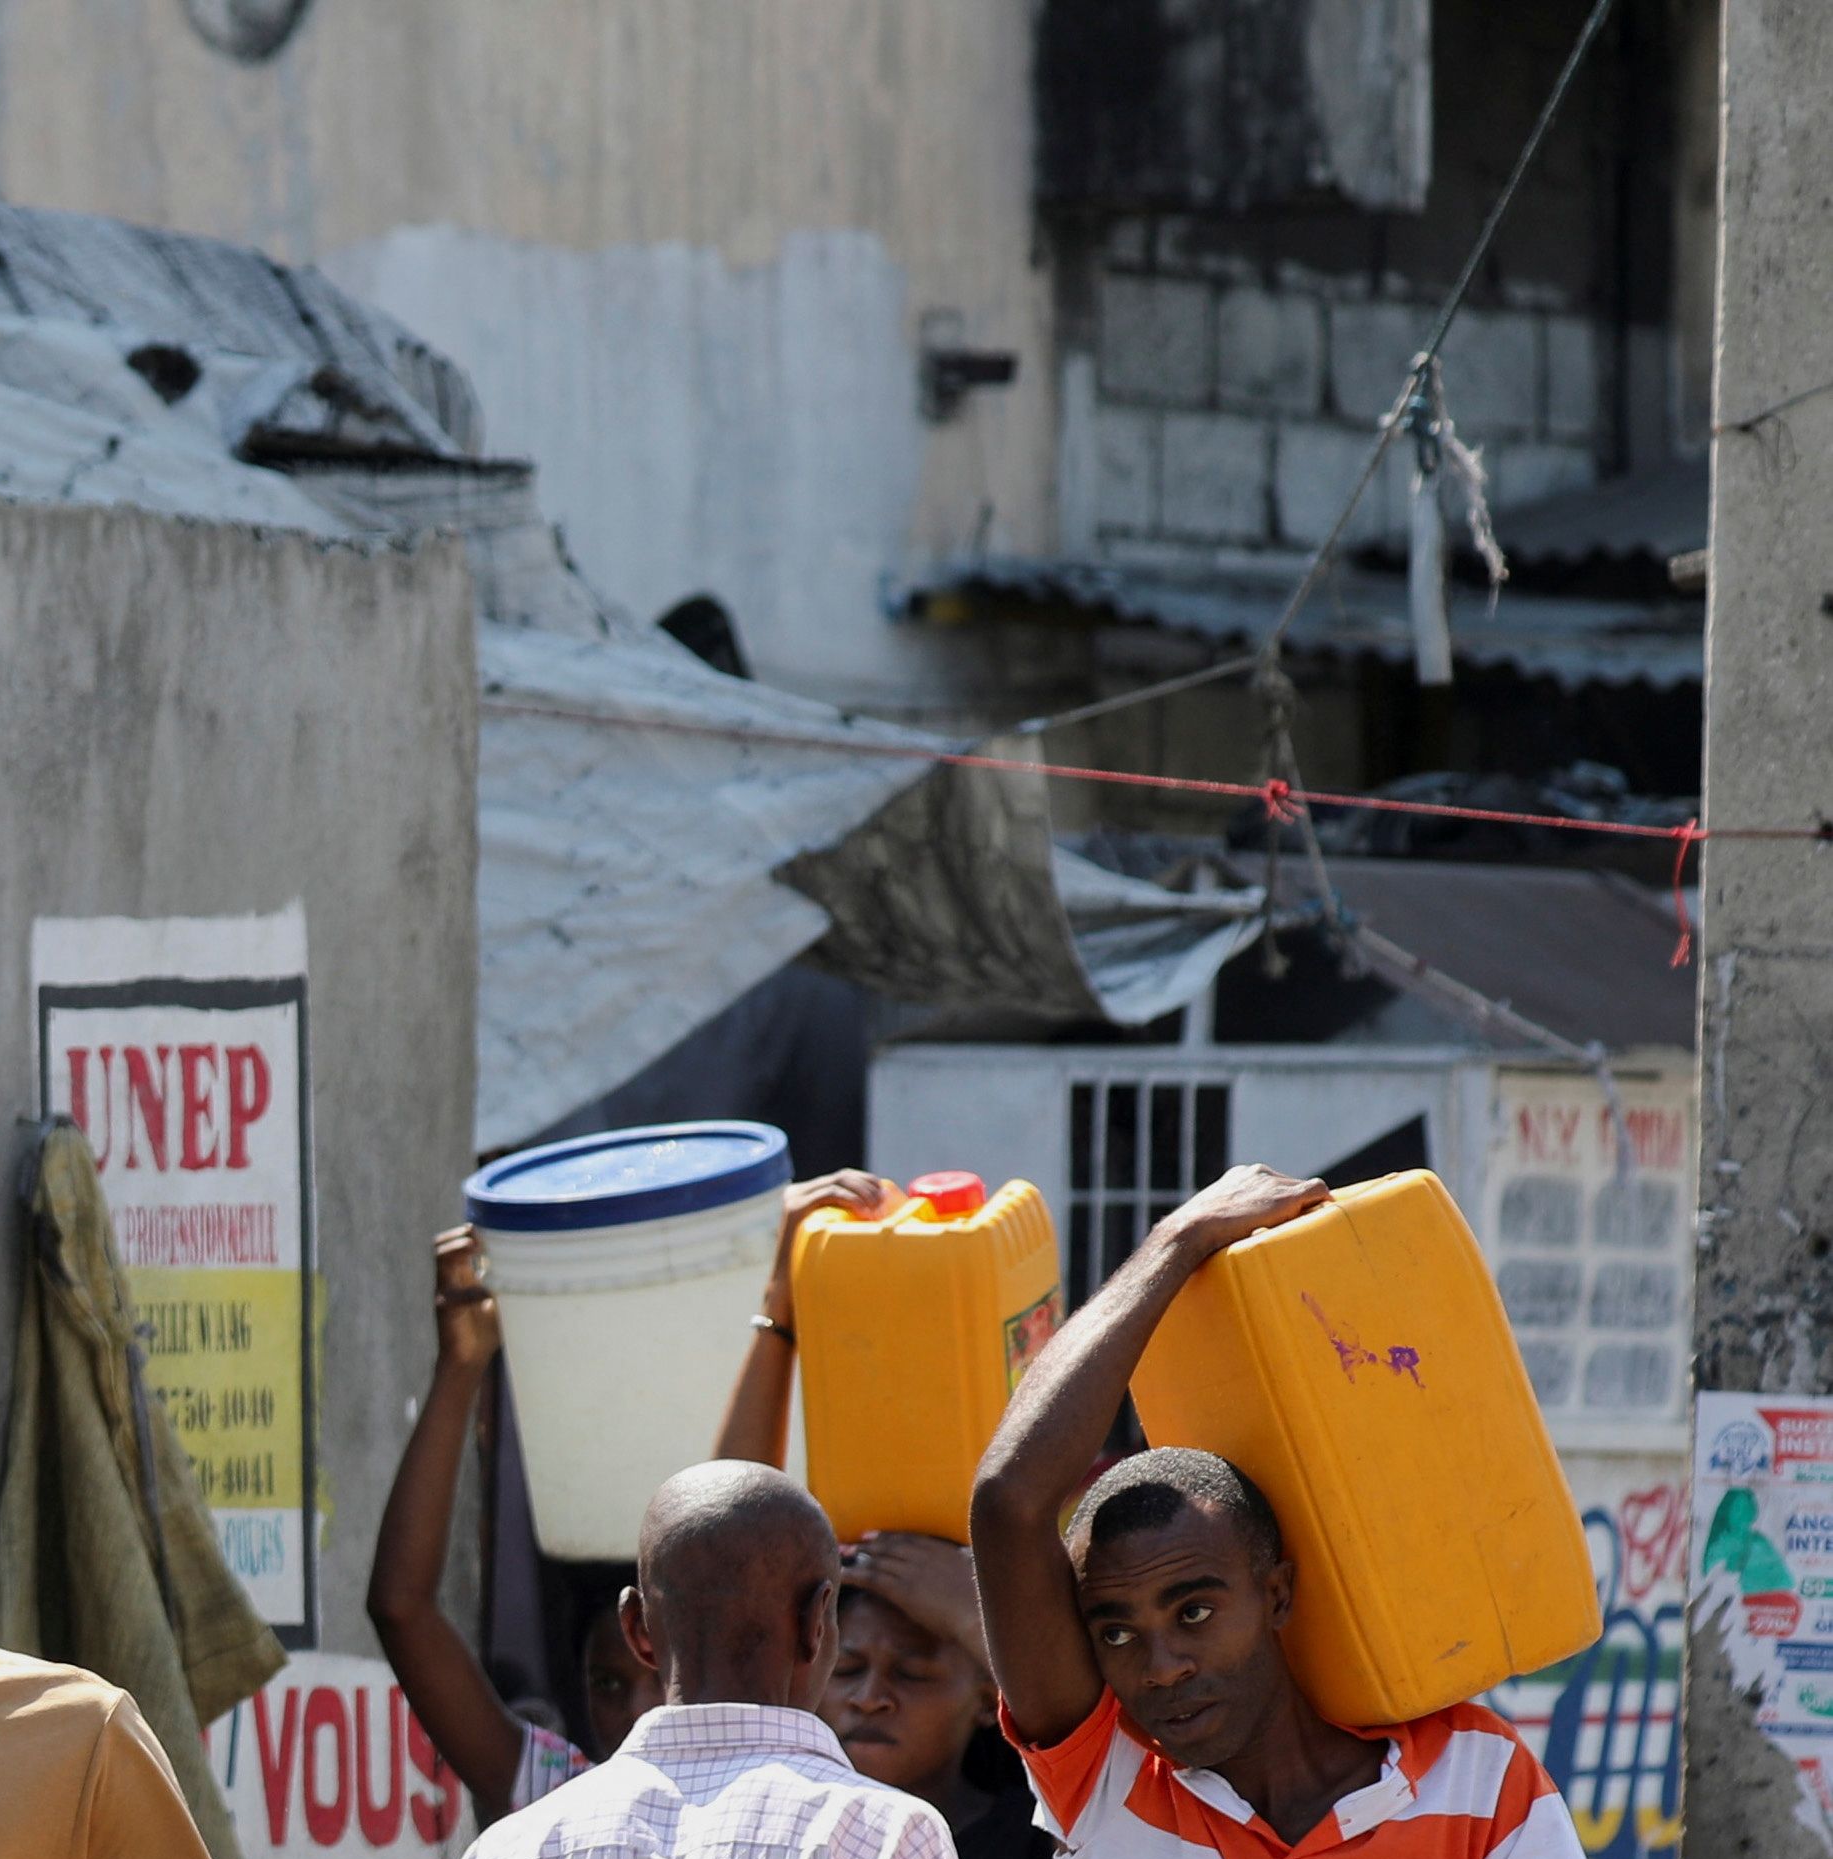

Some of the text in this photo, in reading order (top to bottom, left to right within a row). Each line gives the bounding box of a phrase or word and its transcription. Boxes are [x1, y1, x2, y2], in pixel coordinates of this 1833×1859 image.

[66, 1043, 273, 1174] UNEP
[188, 1452, 276, 1496] 0-4041
[252, 1686, 459, 1848] VOUS
